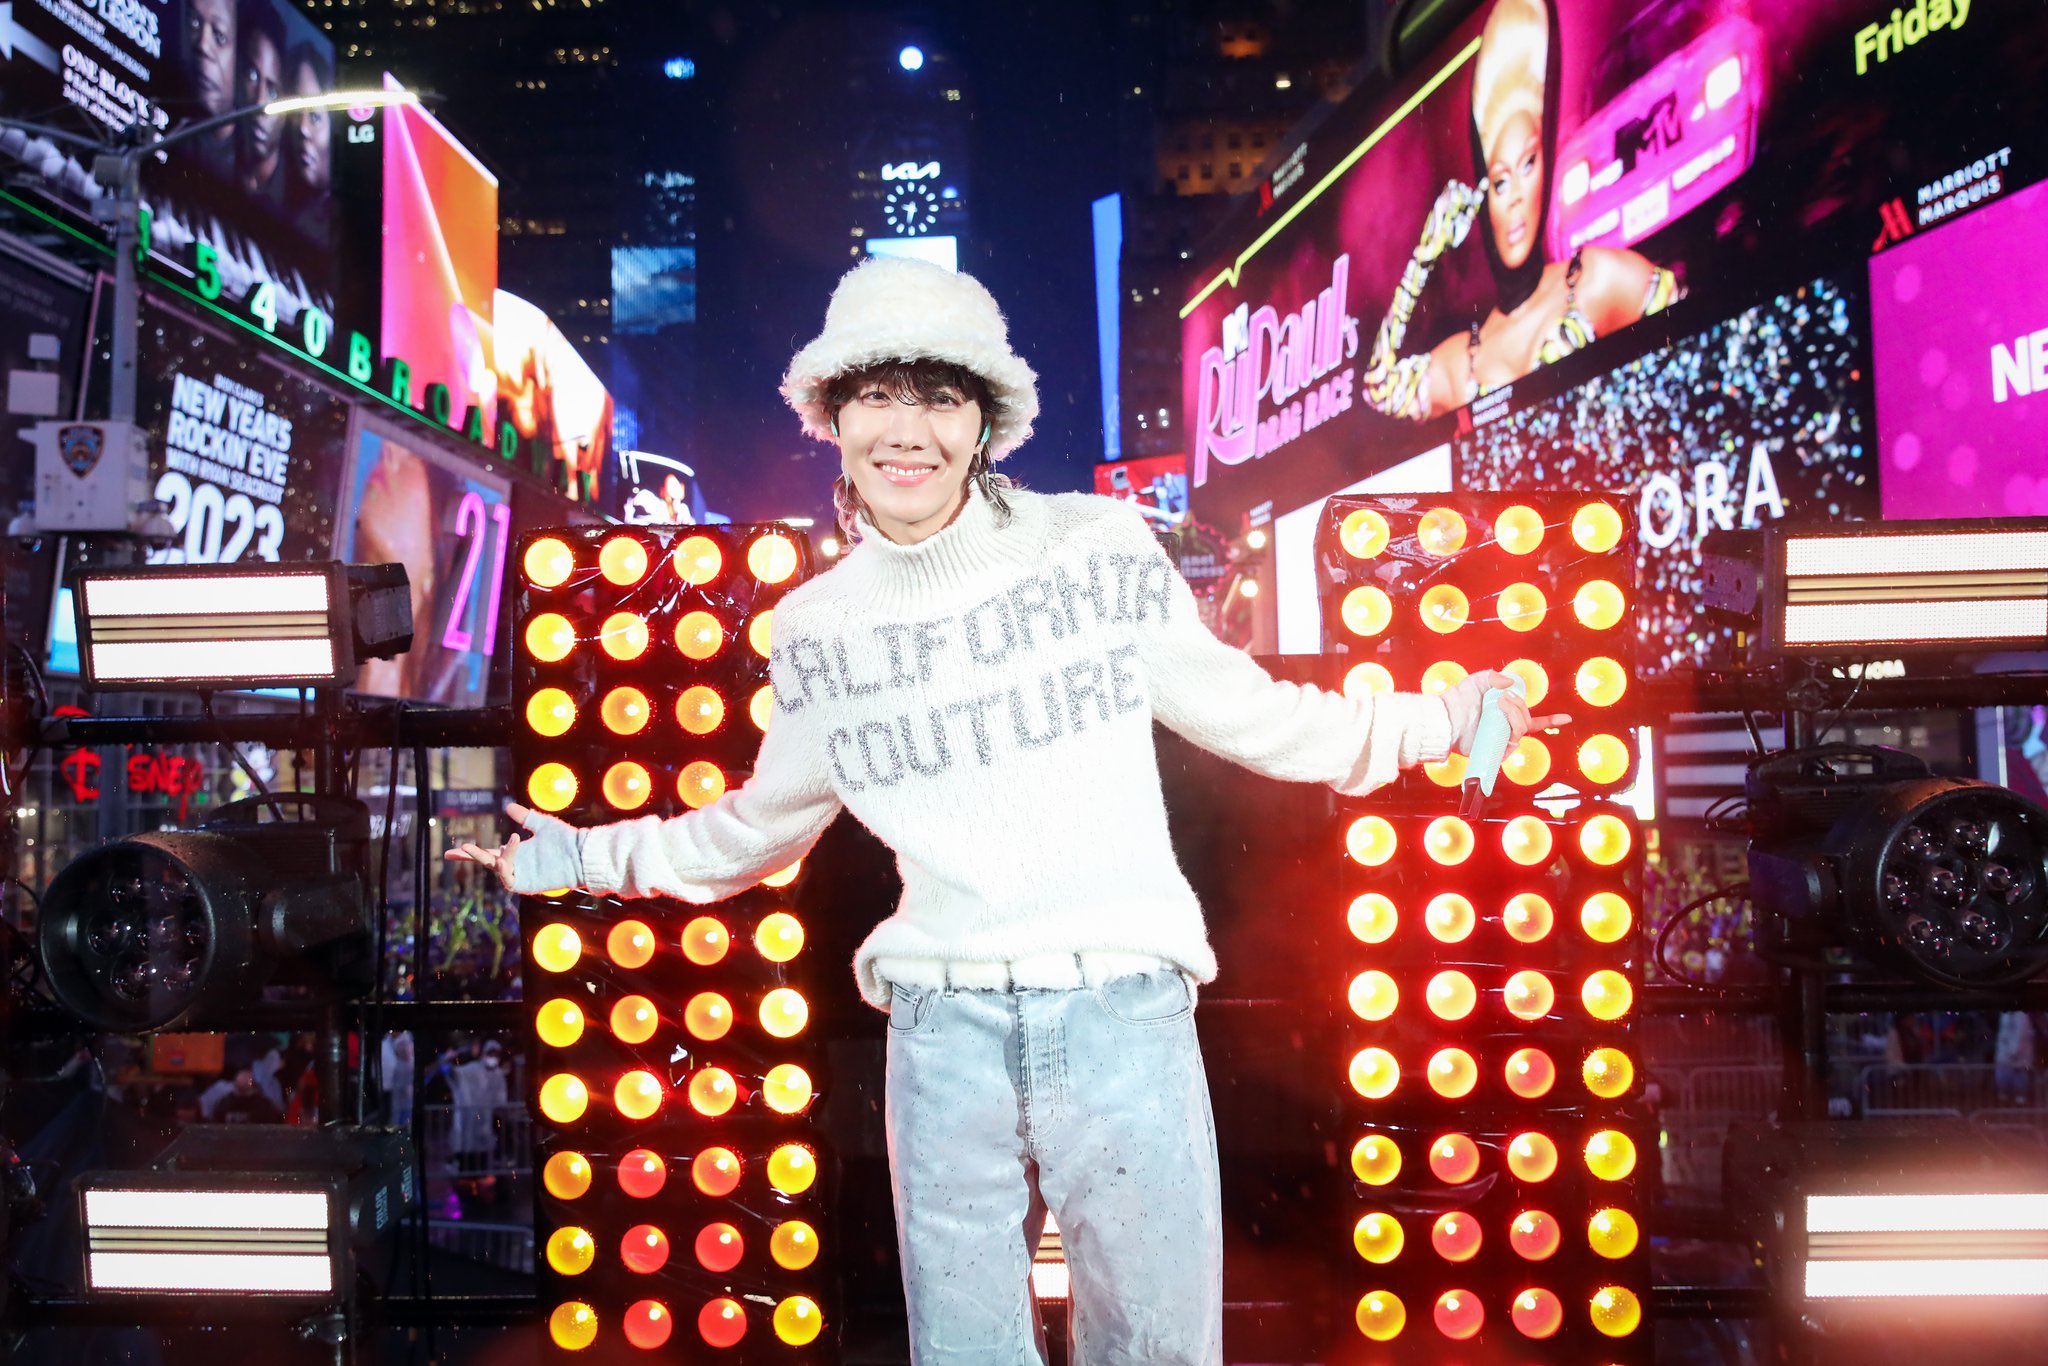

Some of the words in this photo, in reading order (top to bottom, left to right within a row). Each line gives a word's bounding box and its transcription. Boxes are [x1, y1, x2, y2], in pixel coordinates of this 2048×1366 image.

[62, 44, 99, 84] ONE
[1855, 0, 1971, 76] Friday
[348, 124, 375, 144] LG
[1614, 91, 1682, 177] MTV
[1917, 146, 2012, 205] MARRIOTT
[1918, 174, 2001, 226] MARQUIS
[172, 371, 228, 426] NEW
[227, 395, 293, 452] YEAR'S
[1193, 253, 1359, 488] RuPaul's
[167, 409, 253, 471] ROCKIN'
[249, 442, 290, 487] EVE
[1255, 401, 1303, 460] DRAG
[1303, 367, 1354, 432] RACE
[146, 471, 285, 565] 2023
[442, 491, 511, 656] 21
[770, 552, 1173, 715] CALIFORNIA
[826, 643, 1144, 794] COUTURE
